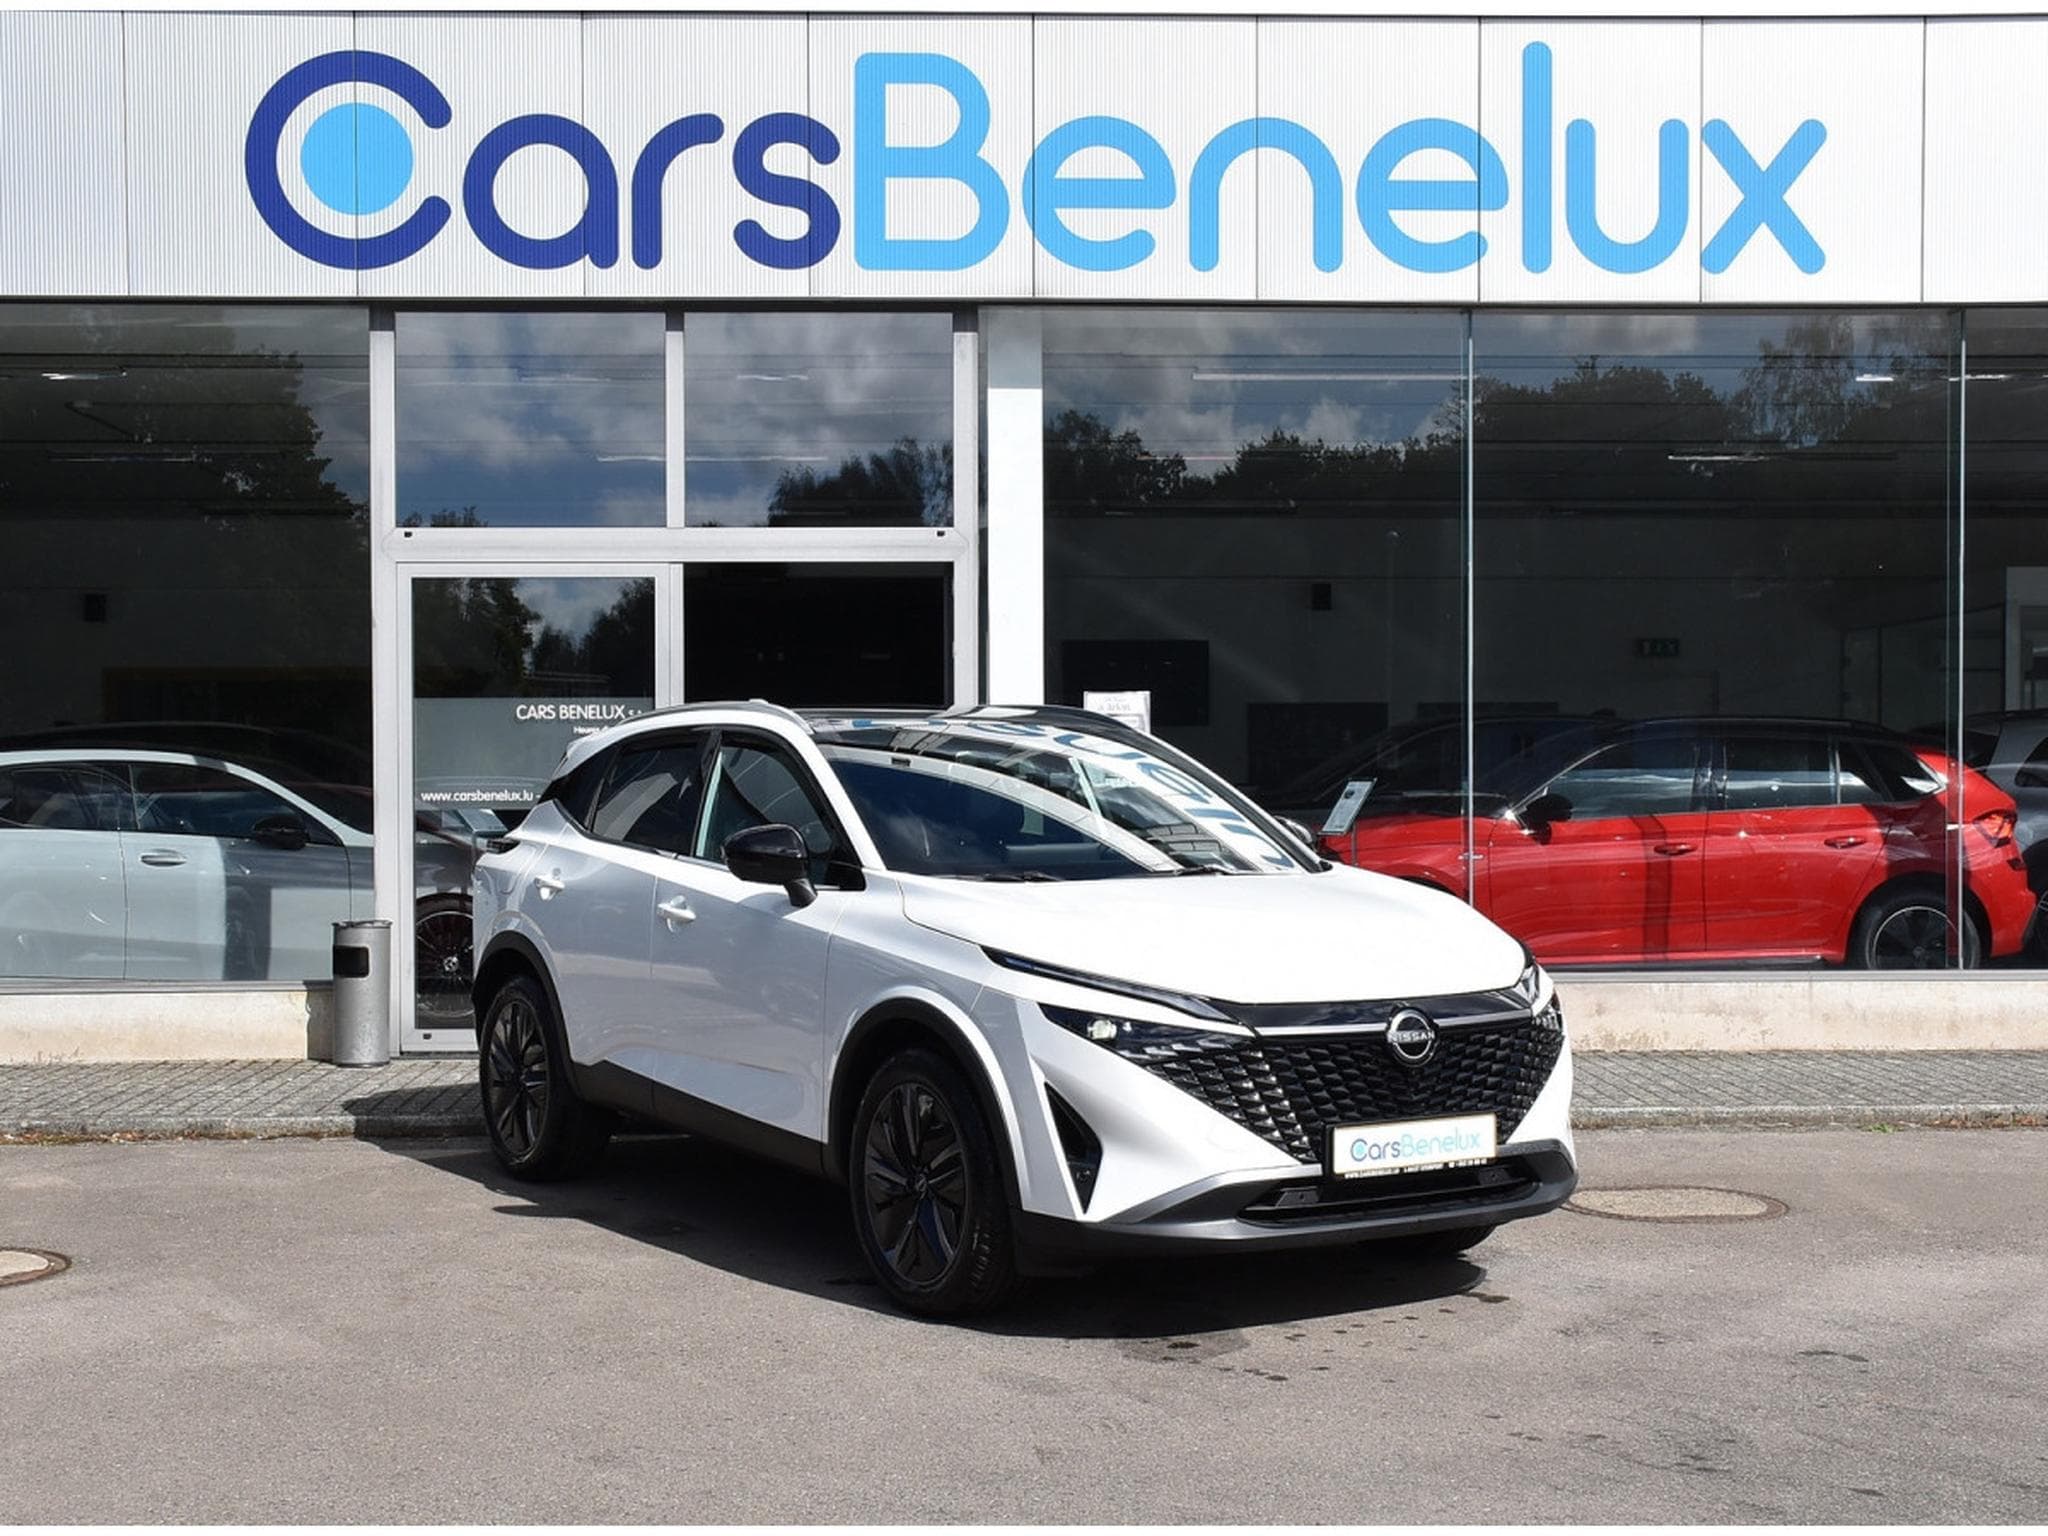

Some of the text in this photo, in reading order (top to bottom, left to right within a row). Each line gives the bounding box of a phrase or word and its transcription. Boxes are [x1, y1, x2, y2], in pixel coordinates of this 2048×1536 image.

[246, 42, 1826, 274] CarsBenelux
[516, 704, 556, 720] CARS
[559, 704, 626, 720] BENELUX
[420, 789, 534, 801] www.carsbenelux.lu
[1387, 1030, 1435, 1043] NISSAN
[1350, 1127, 1481, 1162] CarsBenelux
